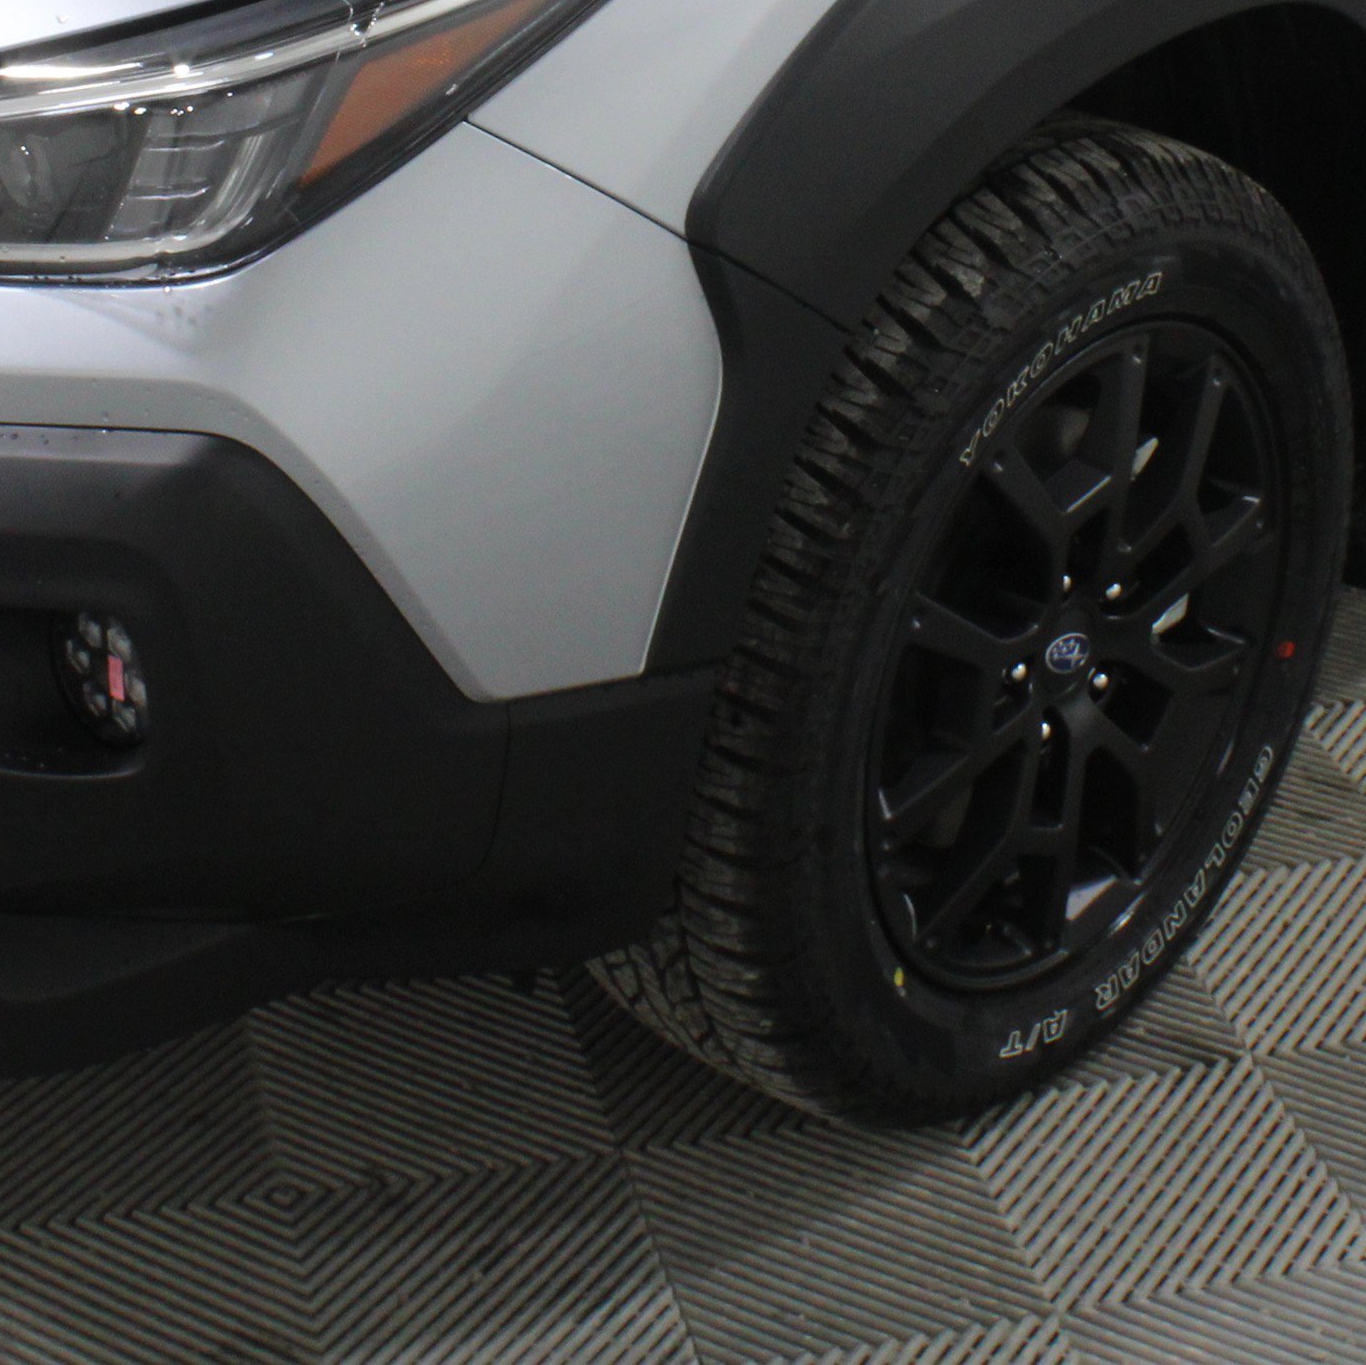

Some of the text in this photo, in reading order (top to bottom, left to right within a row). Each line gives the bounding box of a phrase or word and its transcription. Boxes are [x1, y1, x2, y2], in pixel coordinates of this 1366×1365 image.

[959, 271, 1163, 467] YOKOHAMA
[999, 745, 1274, 1058] GEOLANDAR A/T
